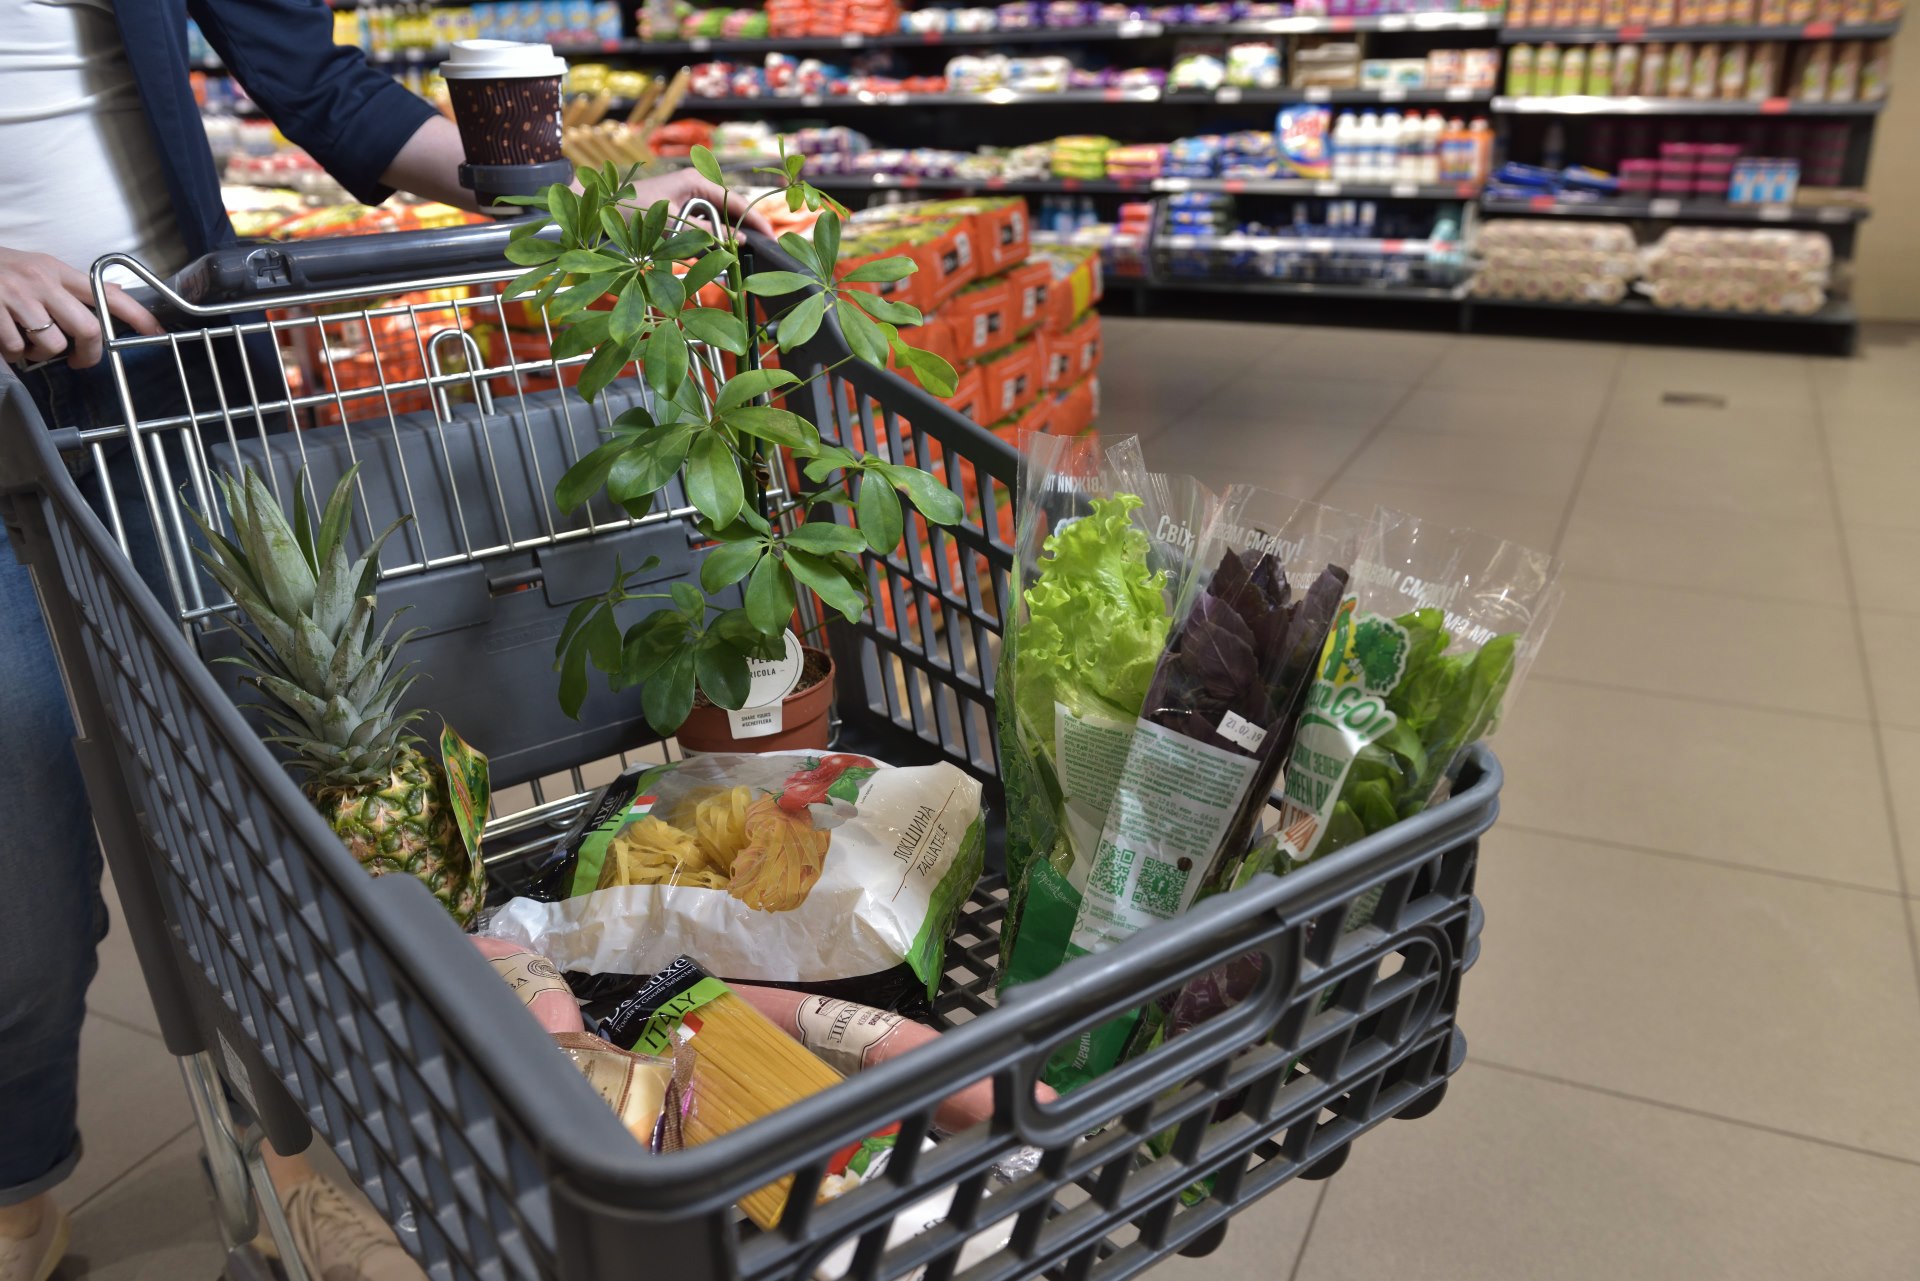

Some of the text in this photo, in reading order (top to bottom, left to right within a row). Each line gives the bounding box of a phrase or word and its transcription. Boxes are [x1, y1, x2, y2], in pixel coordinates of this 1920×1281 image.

[893, 805, 936, 864] ЛОКШИНА
[615, 966, 697, 1033] Foods & Goods Selected
[645, 992, 696, 1049] ITALY
